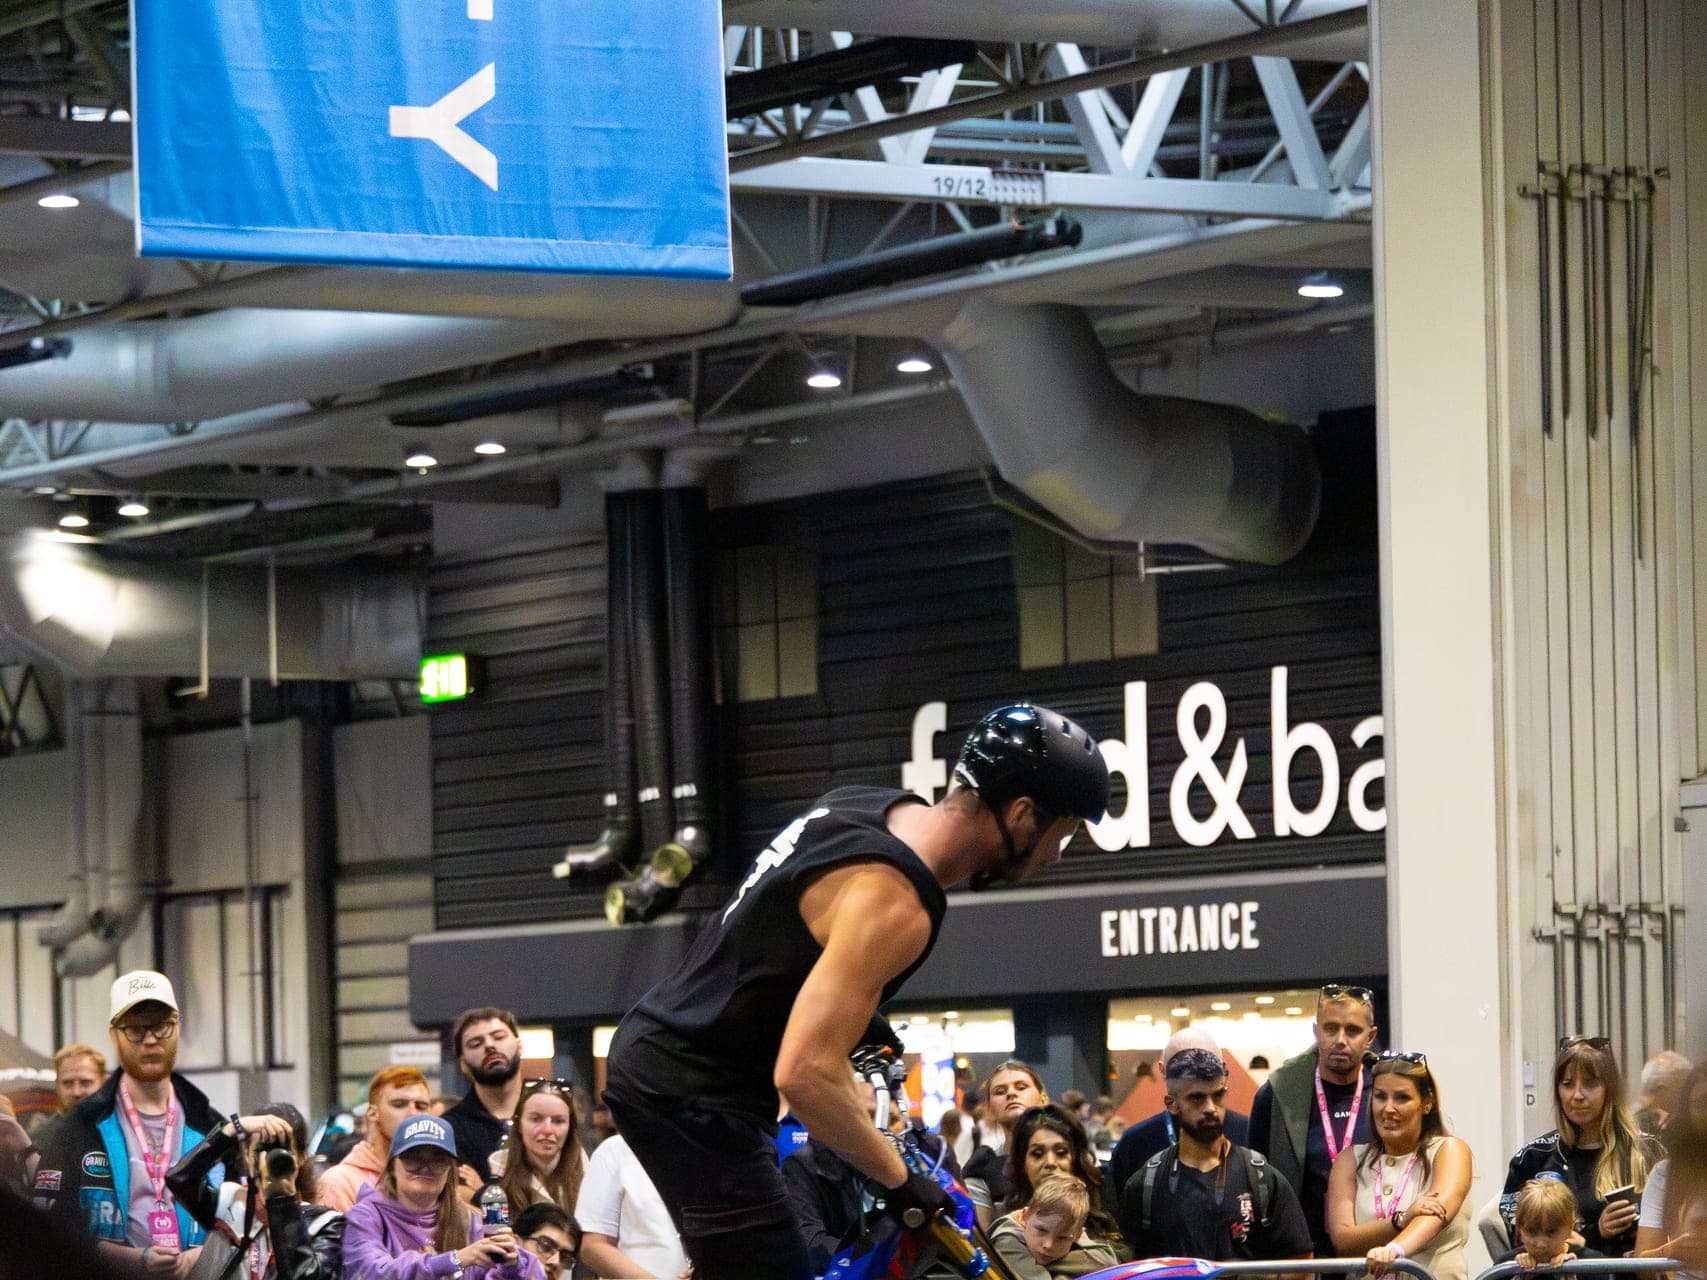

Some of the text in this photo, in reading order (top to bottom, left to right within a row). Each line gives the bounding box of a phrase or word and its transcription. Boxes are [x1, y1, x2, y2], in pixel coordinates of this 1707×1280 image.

[934, 176, 986, 196] 19/12
[1101, 902, 1260, 957] ENTRANCE
[1526, 1094, 1536, 1106] D
[403, 1120, 446, 1140] GRAVITY
